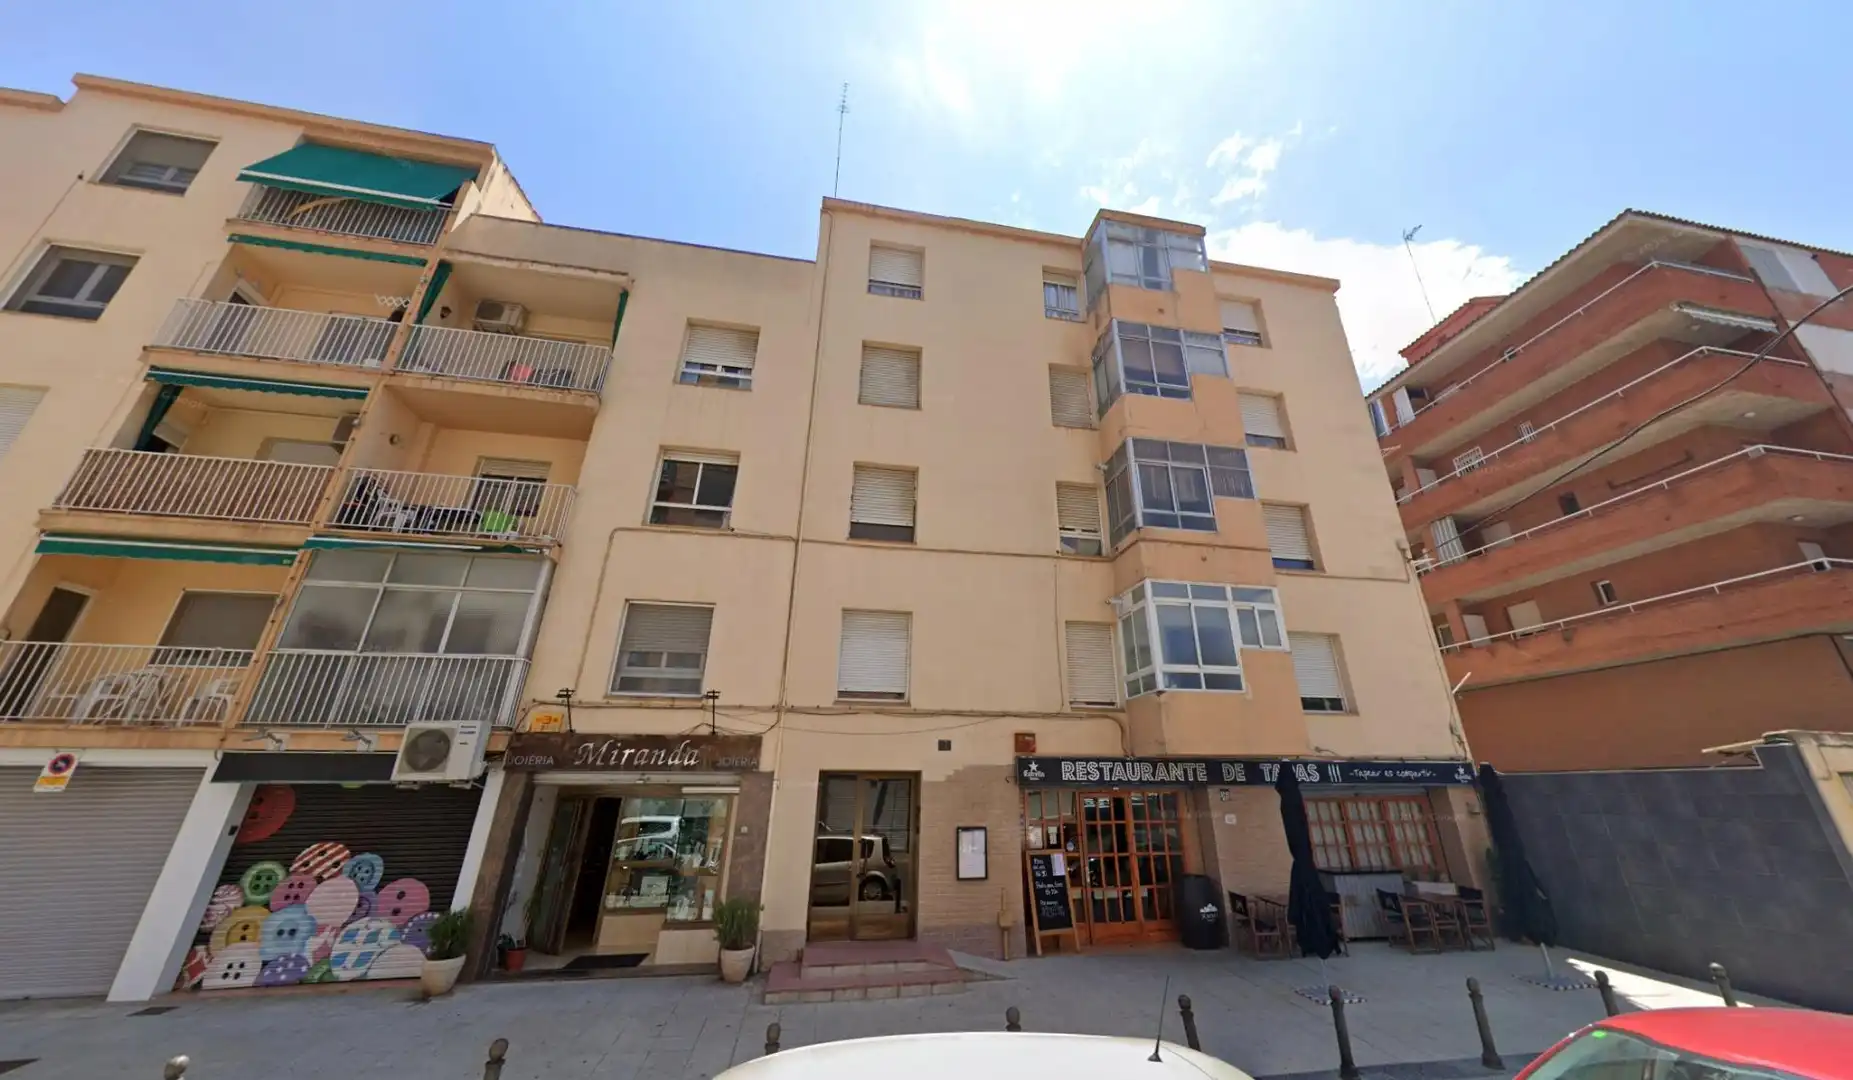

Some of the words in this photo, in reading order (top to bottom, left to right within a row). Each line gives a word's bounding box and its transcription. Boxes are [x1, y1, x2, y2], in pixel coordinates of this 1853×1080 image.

[574, 739, 700, 766] Miranda
[1061, 761, 1207, 782] RESTAURANTE
[1222, 763, 1246, 782] DE
[1259, 763, 1320, 782] TAAS
